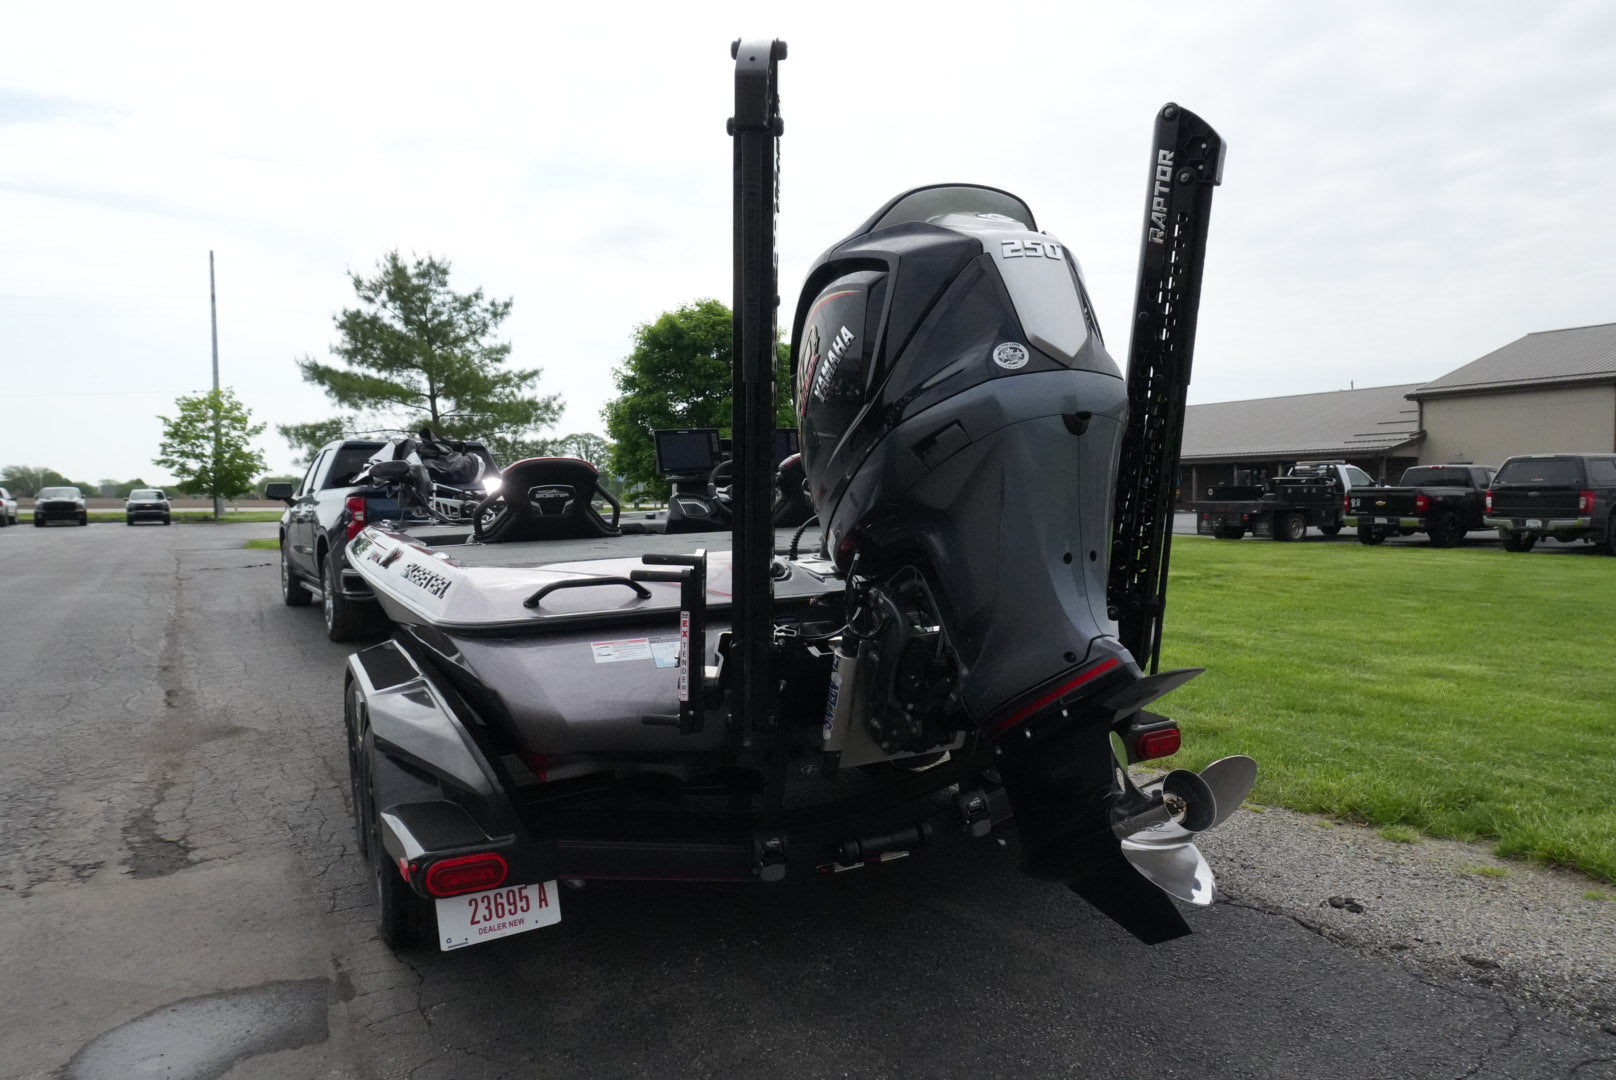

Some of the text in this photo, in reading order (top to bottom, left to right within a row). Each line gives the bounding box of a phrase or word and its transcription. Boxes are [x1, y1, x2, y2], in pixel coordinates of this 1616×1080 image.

[1148, 149, 1175, 244] RAPTOR
[1001, 239, 1062, 261] 250
[814, 325, 856, 403] YAMAHA
[468, 882, 549, 926] 23695 A
[478, 917, 525, 935] DEALER NEW
